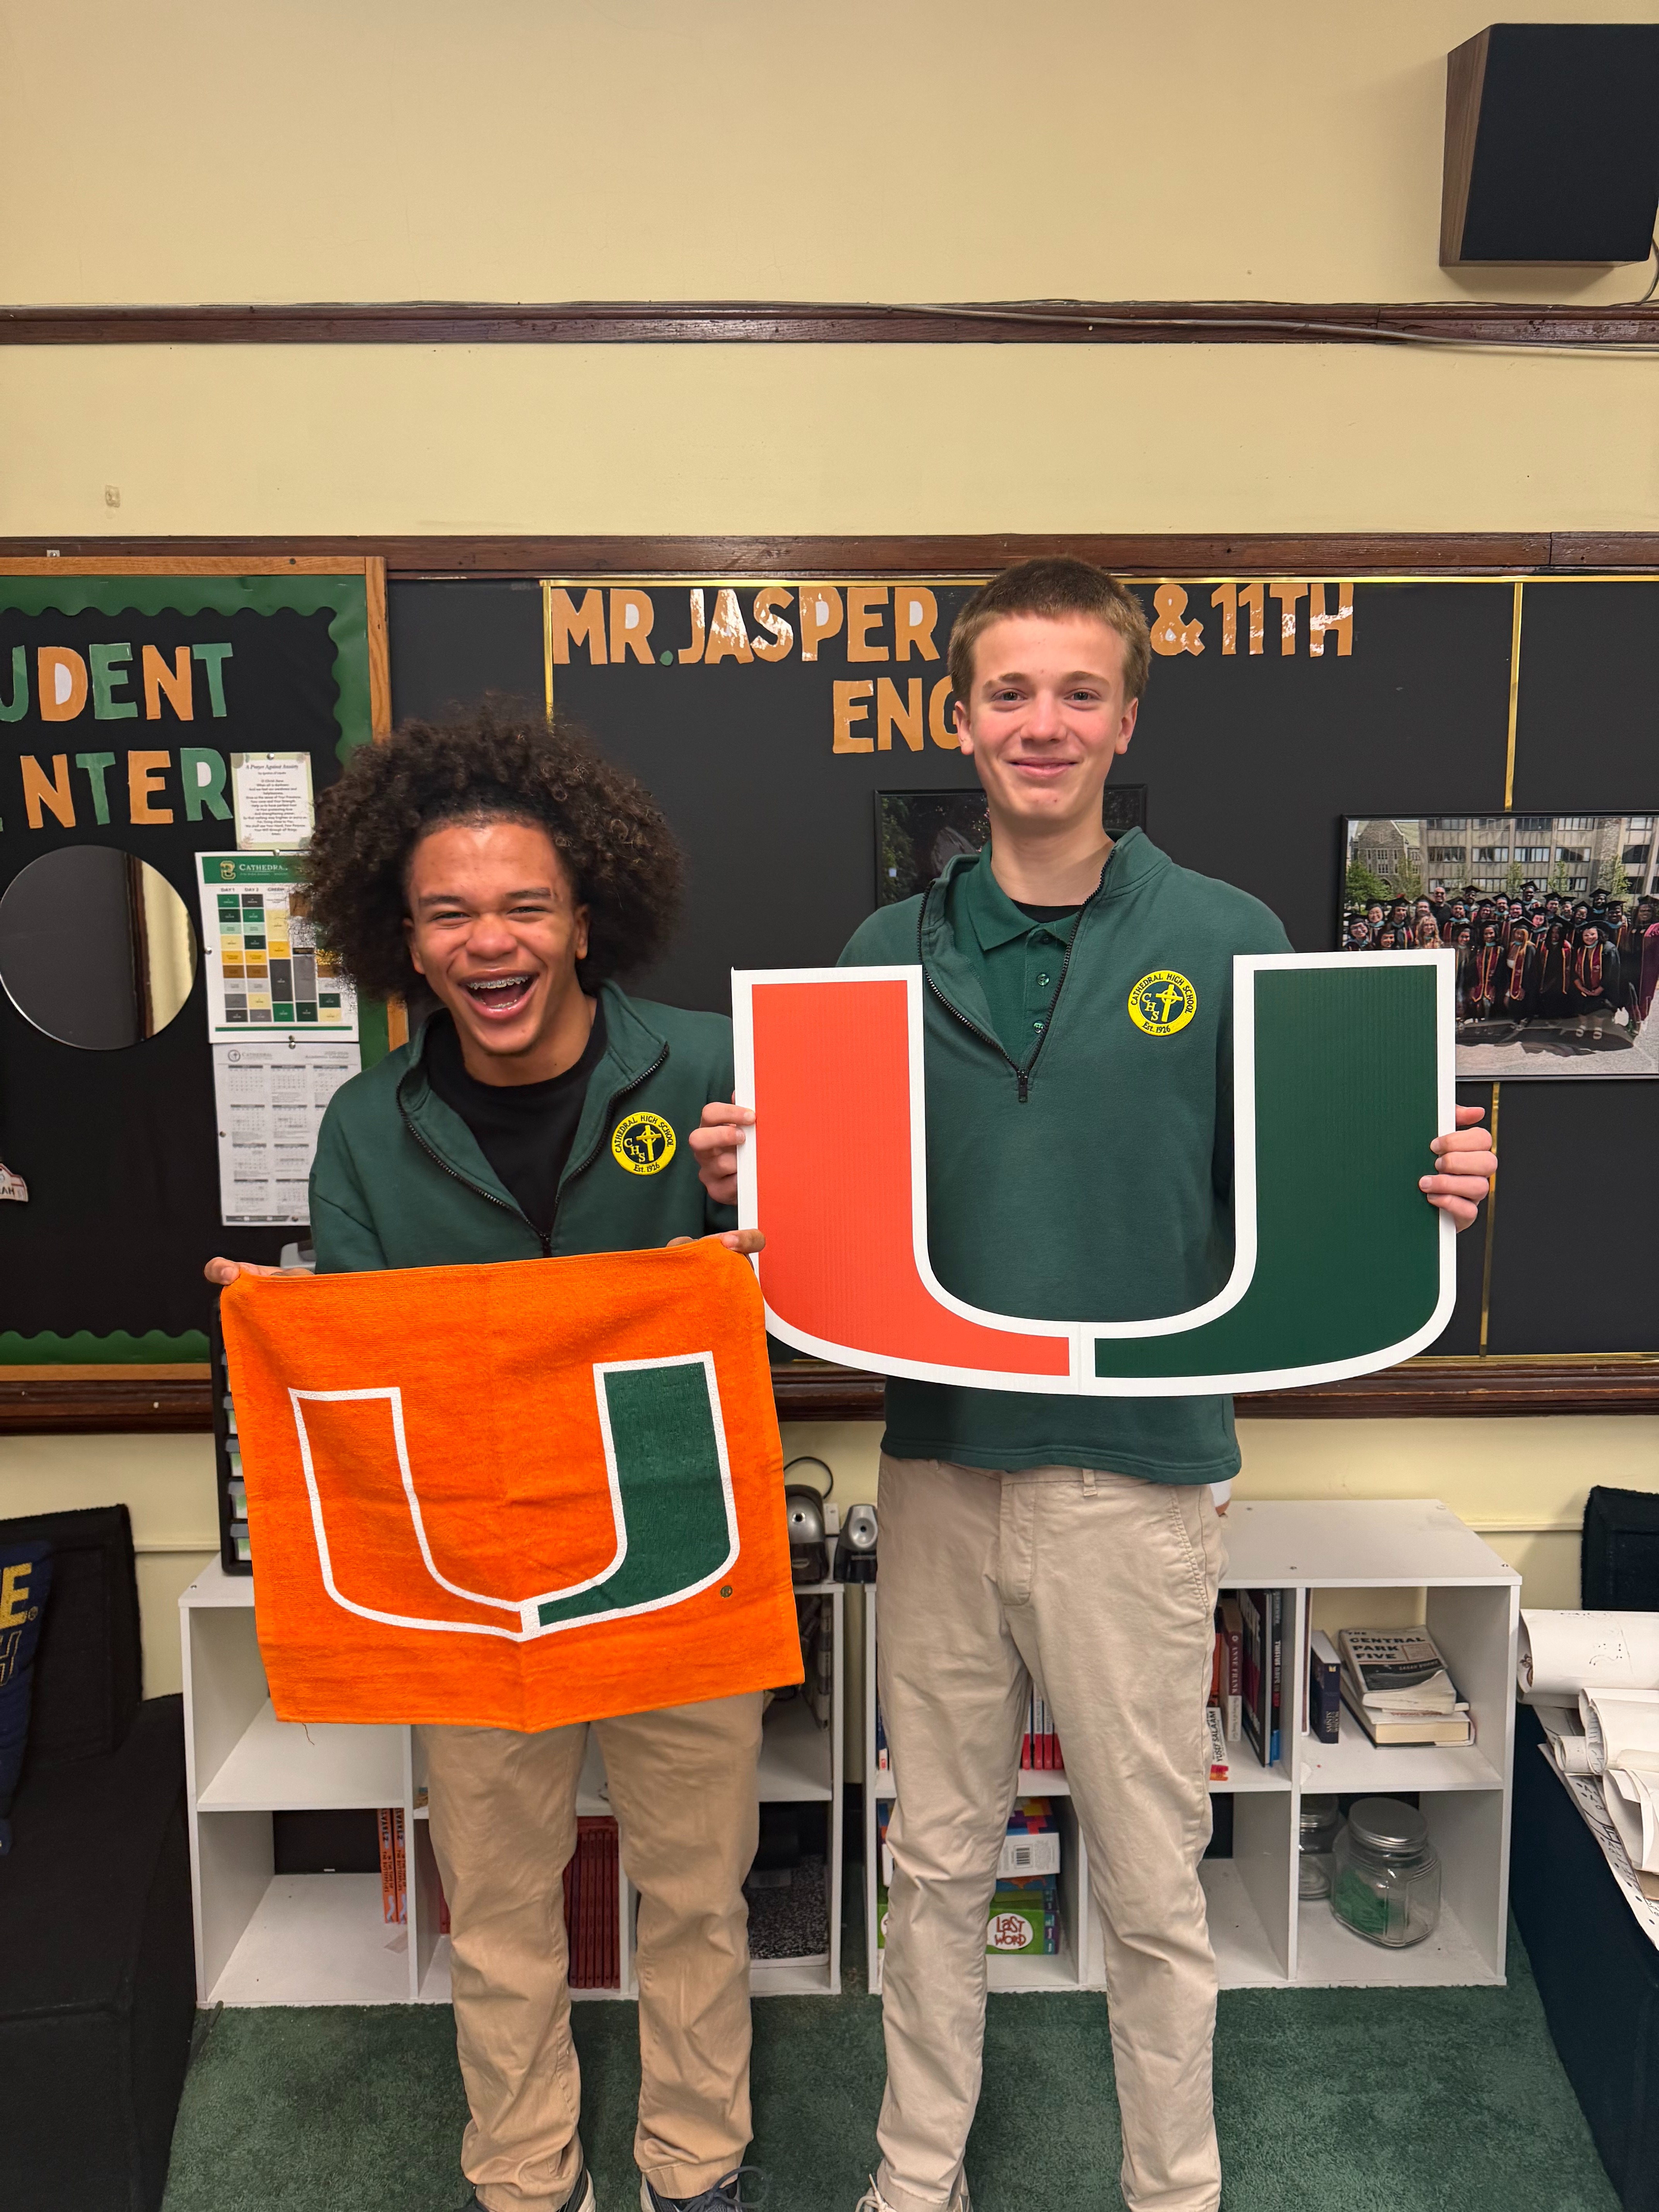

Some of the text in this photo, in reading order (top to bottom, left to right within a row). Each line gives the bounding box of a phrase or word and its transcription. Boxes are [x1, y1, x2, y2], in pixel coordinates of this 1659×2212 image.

[0, 748, 234, 832] NTER
[1130, 973, 1194, 1014] CATHEDRAL HIGH SCHOOL
[1155, 1025, 1171, 1033] 1926
[614, 1115, 674, 1153] CATHEDRAL HIGH SCHOOL
[646, 1162, 660, 1173] 1926
[1209, 1711, 1220, 1742] SALAAM
